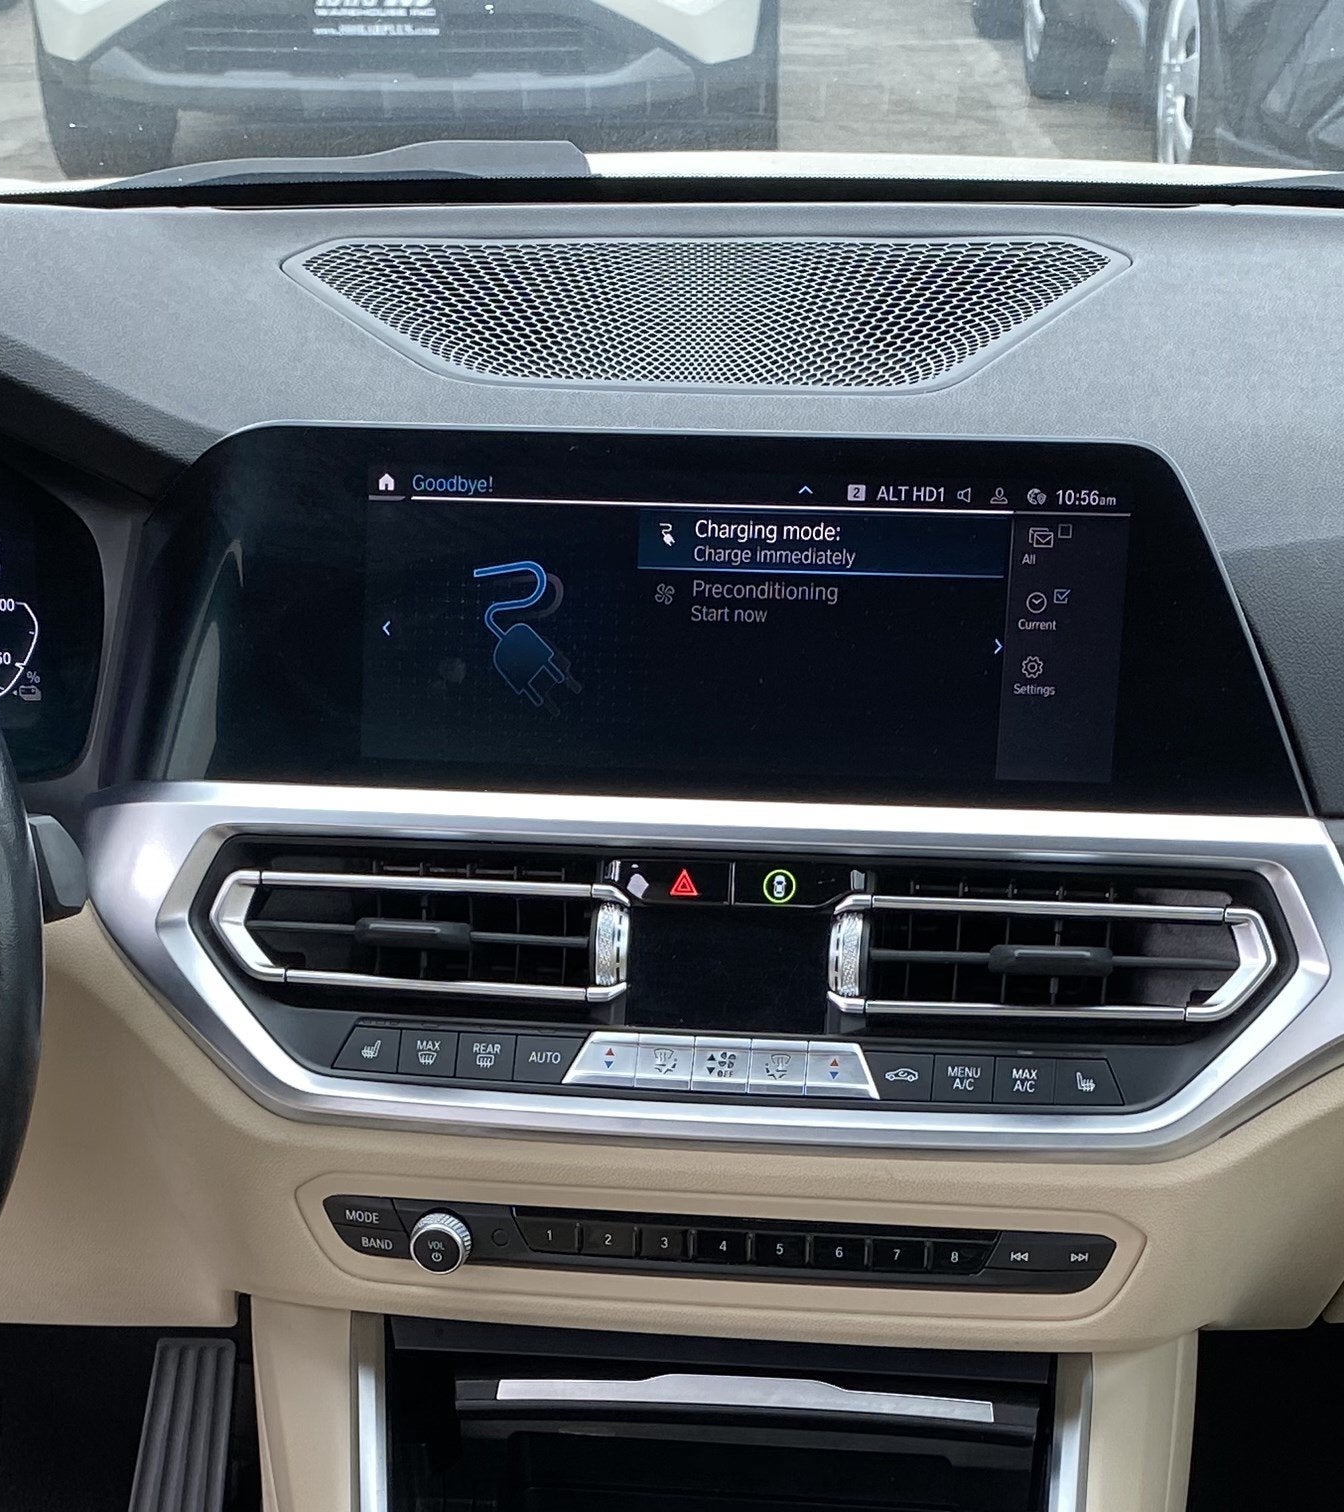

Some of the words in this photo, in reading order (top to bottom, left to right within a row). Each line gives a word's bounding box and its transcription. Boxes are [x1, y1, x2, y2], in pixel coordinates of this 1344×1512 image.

[412, 474, 493, 496] Goodbye!
[877, 485, 909, 501] ALT
[913, 487, 945, 503] HD1
[1056, 489, 1117, 506] 10:56am
[695, 520, 777, 543] Charging
[783, 522, 841, 541] mode:
[694, 545, 751, 566] Charge
[756, 547, 856, 568] immediately
[1022, 554, 1036, 565] All
[692, 580, 839, 605] Preconditioning
[691, 605, 729, 622] Start
[734, 608, 768, 623] now
[1018, 618, 1057, 631] Current
[1013, 683, 1056, 696] Settings
[417, 1040, 441, 1051] MAX
[473, 1043, 501, 1054] REAR
[528, 1051, 561, 1064] AUTO
[717, 1070, 733, 1078] OFF
[948, 1066, 981, 1078] MENU
[1012, 1068, 1037, 1080] MAX
[953, 1078, 974, 1090] A/C
[1013, 1080, 1035, 1092] A/C
[345, 1209, 380, 1224] MODE
[546, 1230, 553, 1241] 1
[605, 1234, 613, 1246] 2
[361, 1236, 393, 1250] BAND
[428, 1240, 445, 1250] VOL
[661, 1237, 669, 1249] 3
[719, 1240, 727, 1252] 4
[776, 1243, 784, 1255] 5
[835, 1246, 844, 1259] 6
[893, 1249, 901, 1261] 7
[950, 1251, 959, 1263] 8
